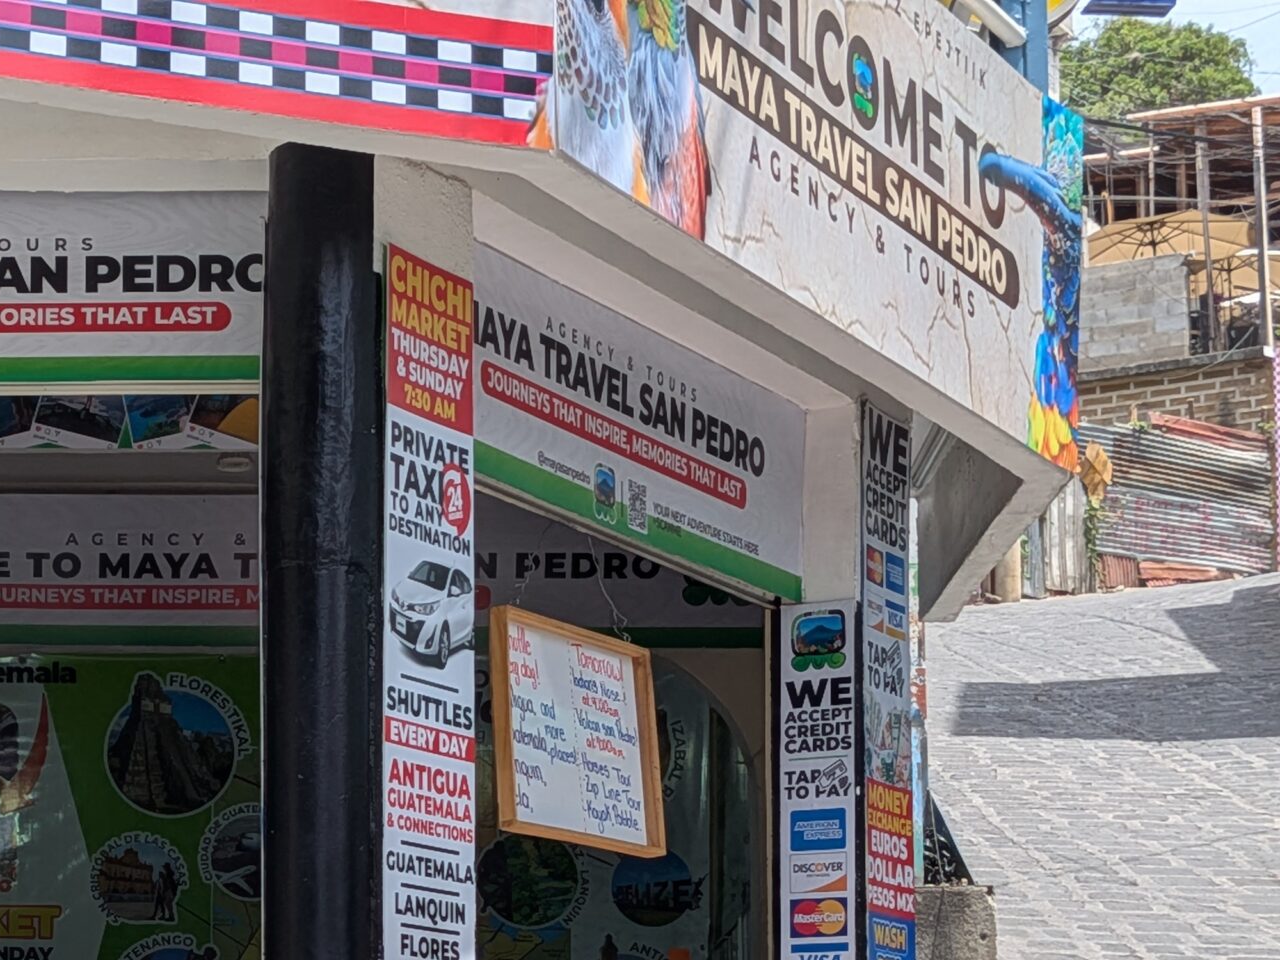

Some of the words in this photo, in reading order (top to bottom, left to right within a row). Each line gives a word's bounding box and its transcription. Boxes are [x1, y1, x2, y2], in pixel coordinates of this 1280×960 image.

[699, 24, 780, 132] MAYA
[785, 88, 881, 201] TRAVEL
[884, 164, 933, 241] SAN
[937, 199, 1008, 297] PEDRO
[955, 117, 1007, 231] TO
[750, 136, 856, 236] AGENCY
[875, 225, 885, 256] &
[904, 244, 976, 319] TOURS
[391, 255, 472, 323] CHICHI
[82, 306, 148, 325] THAT
[155, 306, 216, 324] LAST
[391, 303, 470, 353] MARKET
[546, 316, 616, 362] AGENCY
[627, 356, 633, 371] &
[646, 365, 697, 402] TOURS
[540, 333, 634, 419] TRAVEL
[640, 383, 686, 442] SAN
[692, 410, 765, 478] PEDRO
[390, 420, 469, 476] PRIVATE
[487, 367, 550, 414] JOURNEYS
[553, 397, 582, 430] THAT
[584, 410, 630, 454] INSPIRE,
[632, 435, 688, 473] MEMORIES
[690, 460, 715, 489] THAT
[717, 477, 742, 501] LAST
[869, 407, 909, 477] WE
[866, 460, 907, 497] ACCEPT
[865, 484, 907, 526] CREDIT
[66, 533, 206, 546] AGENCY
[234, 533, 246, 546] &
[389, 512, 470, 557] DESTINATION
[865, 509, 906, 552] CARDS
[27, 551, 82, 579] TO
[99, 552, 218, 579] MAYA
[516, 552, 661, 579] PEDRO
[91, 588, 146, 605] THAT
[151, 589, 241, 607] INSPIRE,
[571, 643, 624, 681] Tomorrow!
[387, 686, 472, 730] SHUTTLES
[785, 676, 852, 709] WE
[228, 708, 249, 756] TIKAL
[784, 707, 852, 724] ACCEPT
[784, 721, 852, 739] CREDIT
[784, 736, 852, 754] CARDS
[389, 758, 471, 800] ANTIGUA
[784, 786, 809, 800] TO
[869, 783, 910, 815] MONEY
[795, 821, 838, 830] AMERICAN
[804, 830, 842, 839] EXPRESS
[868, 811, 912, 836] EXCHANGE
[871, 830, 907, 860] EUROS
[395, 892, 465, 926] LANQUIN
[566, 870, 589, 925] LANQUIN
[794, 912, 845, 923] MasterCard
